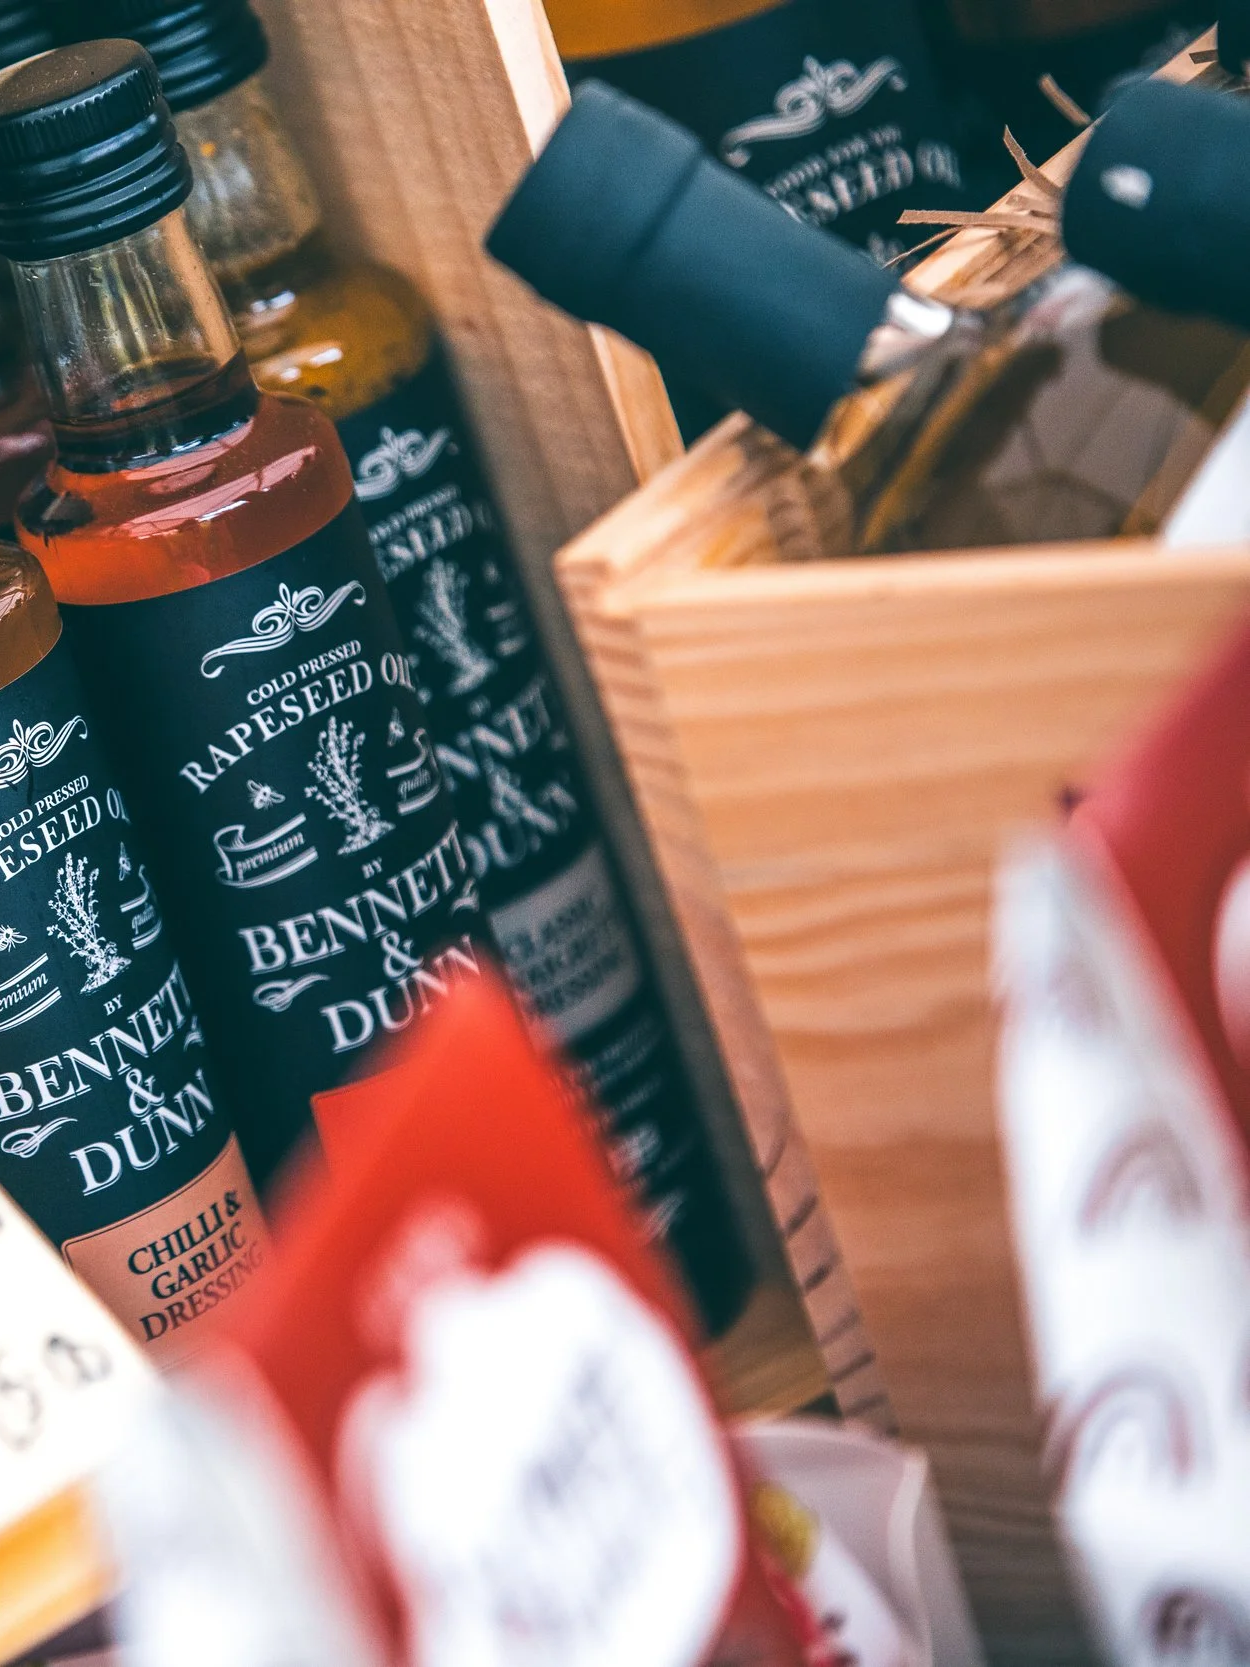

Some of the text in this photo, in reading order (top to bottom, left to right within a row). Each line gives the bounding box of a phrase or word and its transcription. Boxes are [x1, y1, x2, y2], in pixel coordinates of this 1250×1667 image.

[246, 639, 362, 706] COLD PRESSED
[179, 660, 373, 794] RAPESEED
[35, 775, 89, 817] PRESSED
[236, 832, 305, 880] premium
[361, 858, 383, 879] BY
[381, 930, 424, 979] &
[103, 994, 123, 1016] BY
[319, 934, 481, 1054] DUNN
[125, 1067, 165, 1118] &
[69, 1068, 214, 1196] DUNN
[128, 1190, 242, 1275] CHILLI &
[151, 1221, 246, 1300] GARLIC
[139, 1243, 263, 1342] DRESSING
